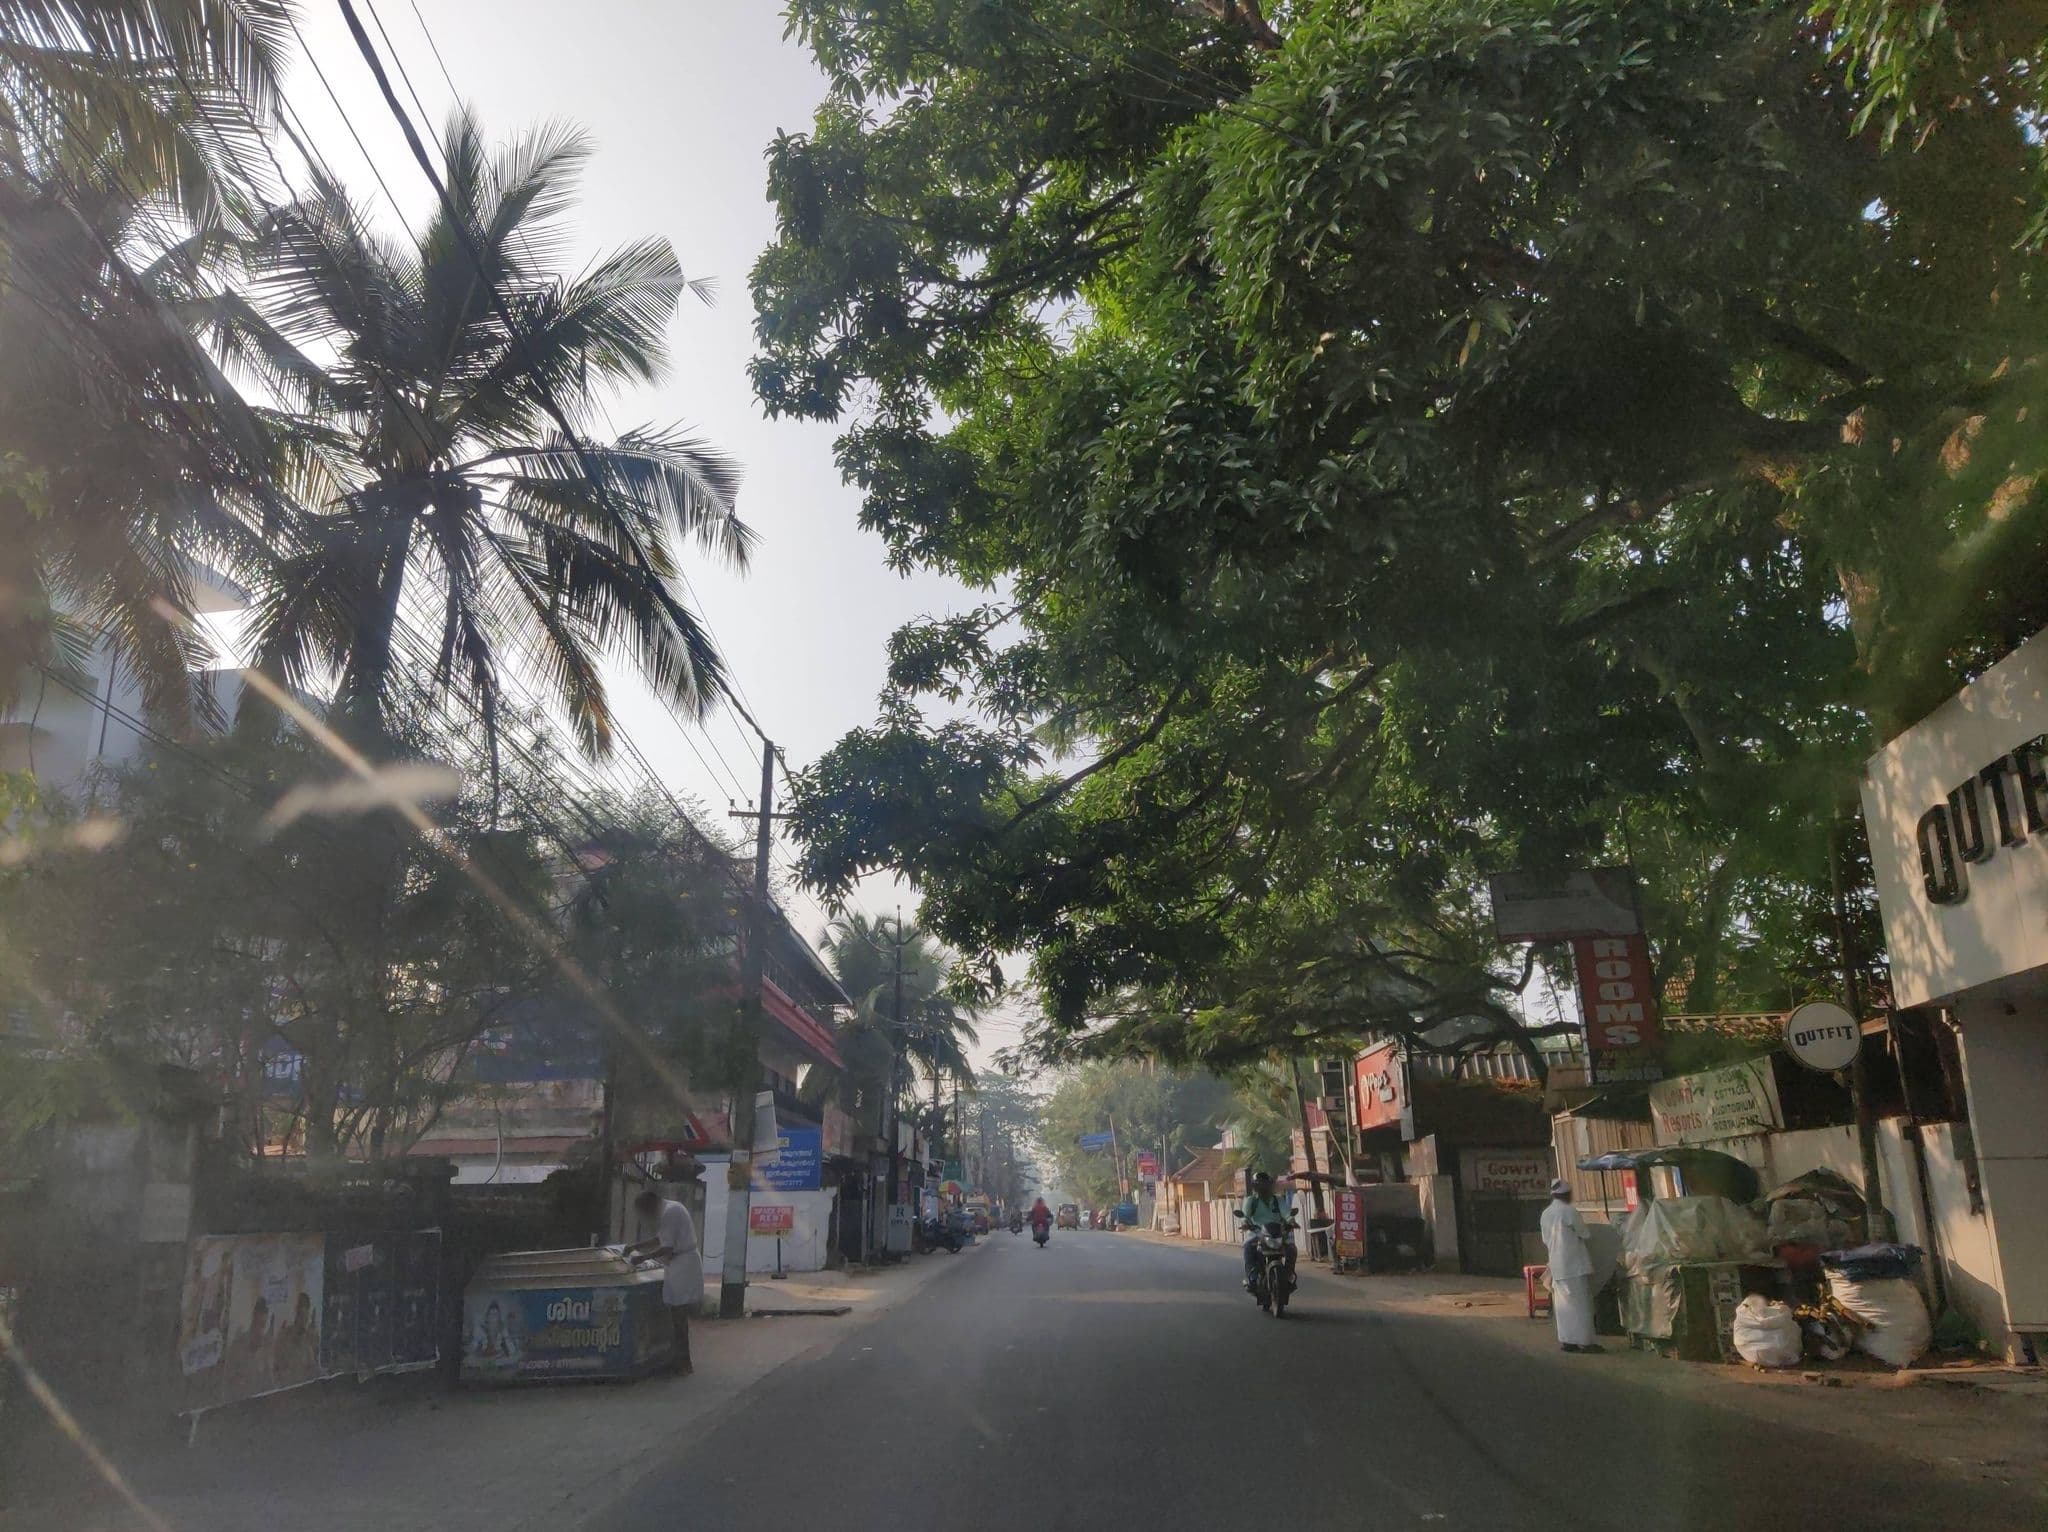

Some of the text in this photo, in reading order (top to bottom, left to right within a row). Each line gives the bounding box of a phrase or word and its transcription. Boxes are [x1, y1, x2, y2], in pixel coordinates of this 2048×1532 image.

[1593, 938, 1644, 1045] ROOMS
[1794, 1025, 1853, 1047] OUTFIT
[1662, 1111, 1702, 1133] Resorts
[1340, 1193, 1359, 1240] ROOMS
[546, 1297, 590, 1321] ശിവ
